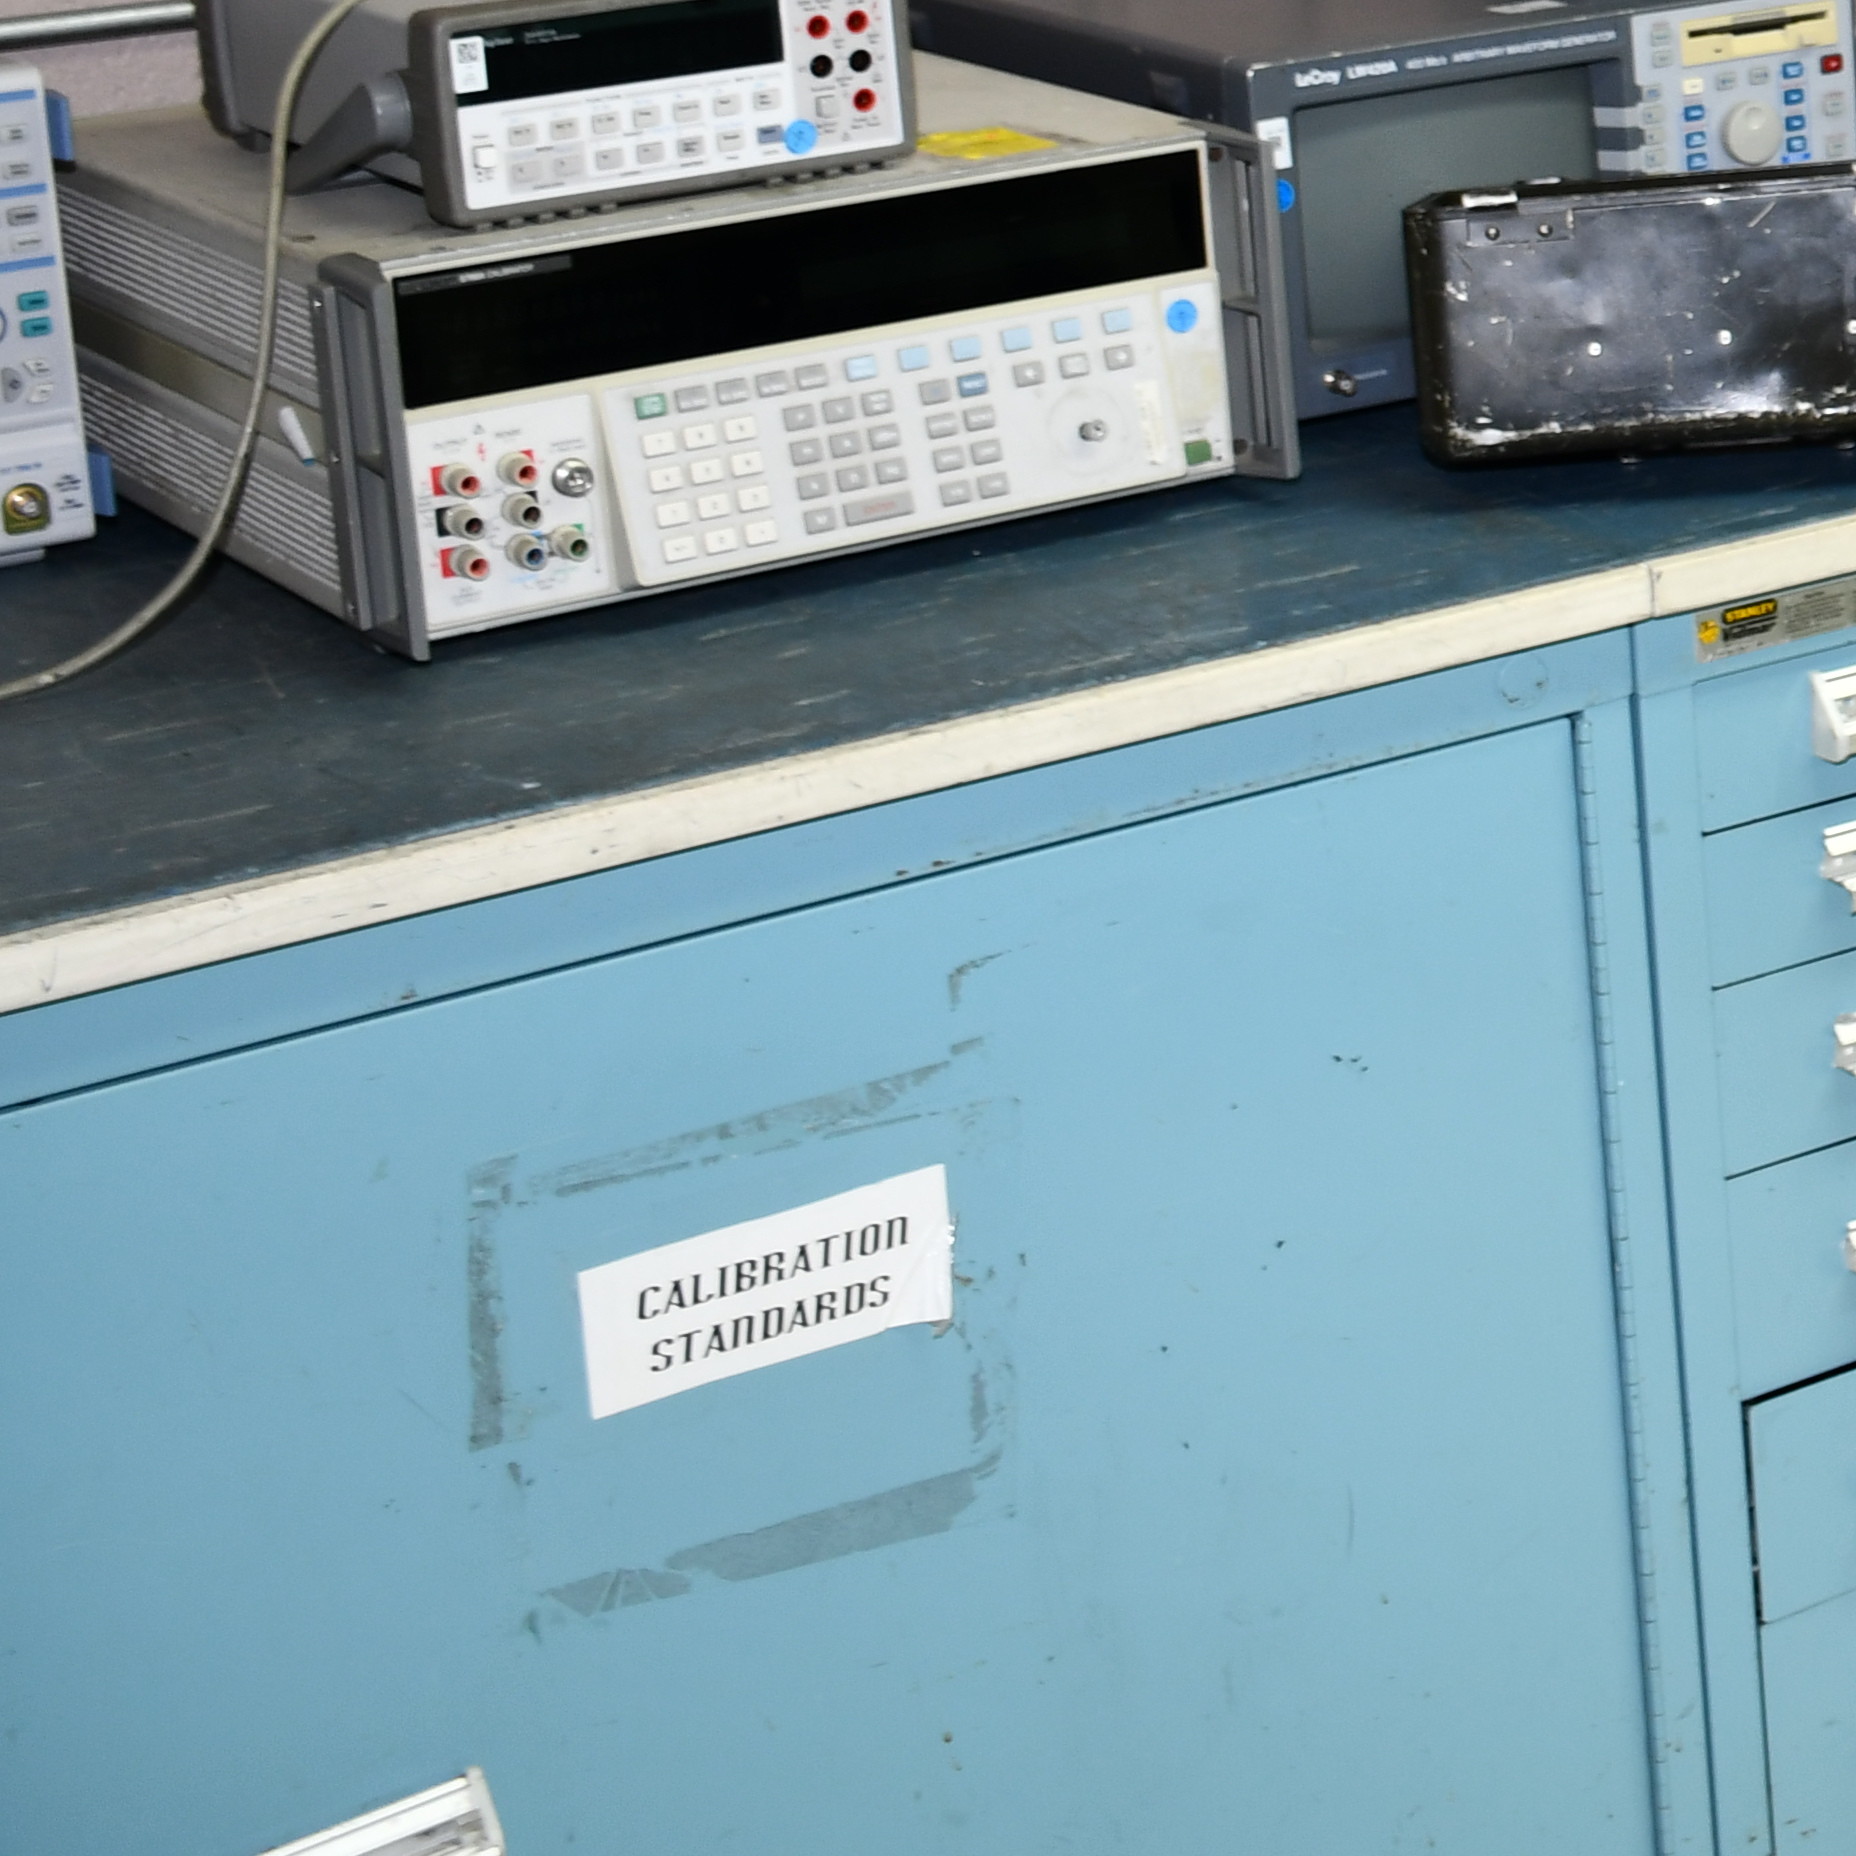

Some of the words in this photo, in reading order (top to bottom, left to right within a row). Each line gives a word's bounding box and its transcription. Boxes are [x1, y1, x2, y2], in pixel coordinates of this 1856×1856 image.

[1293, 68, 1342, 88] LeCroy
[1723, 600, 1777, 623] STANLEY
[636, 1215, 909, 1320] CALIBRATION
[649, 1274, 891, 1372] STANDARDS
